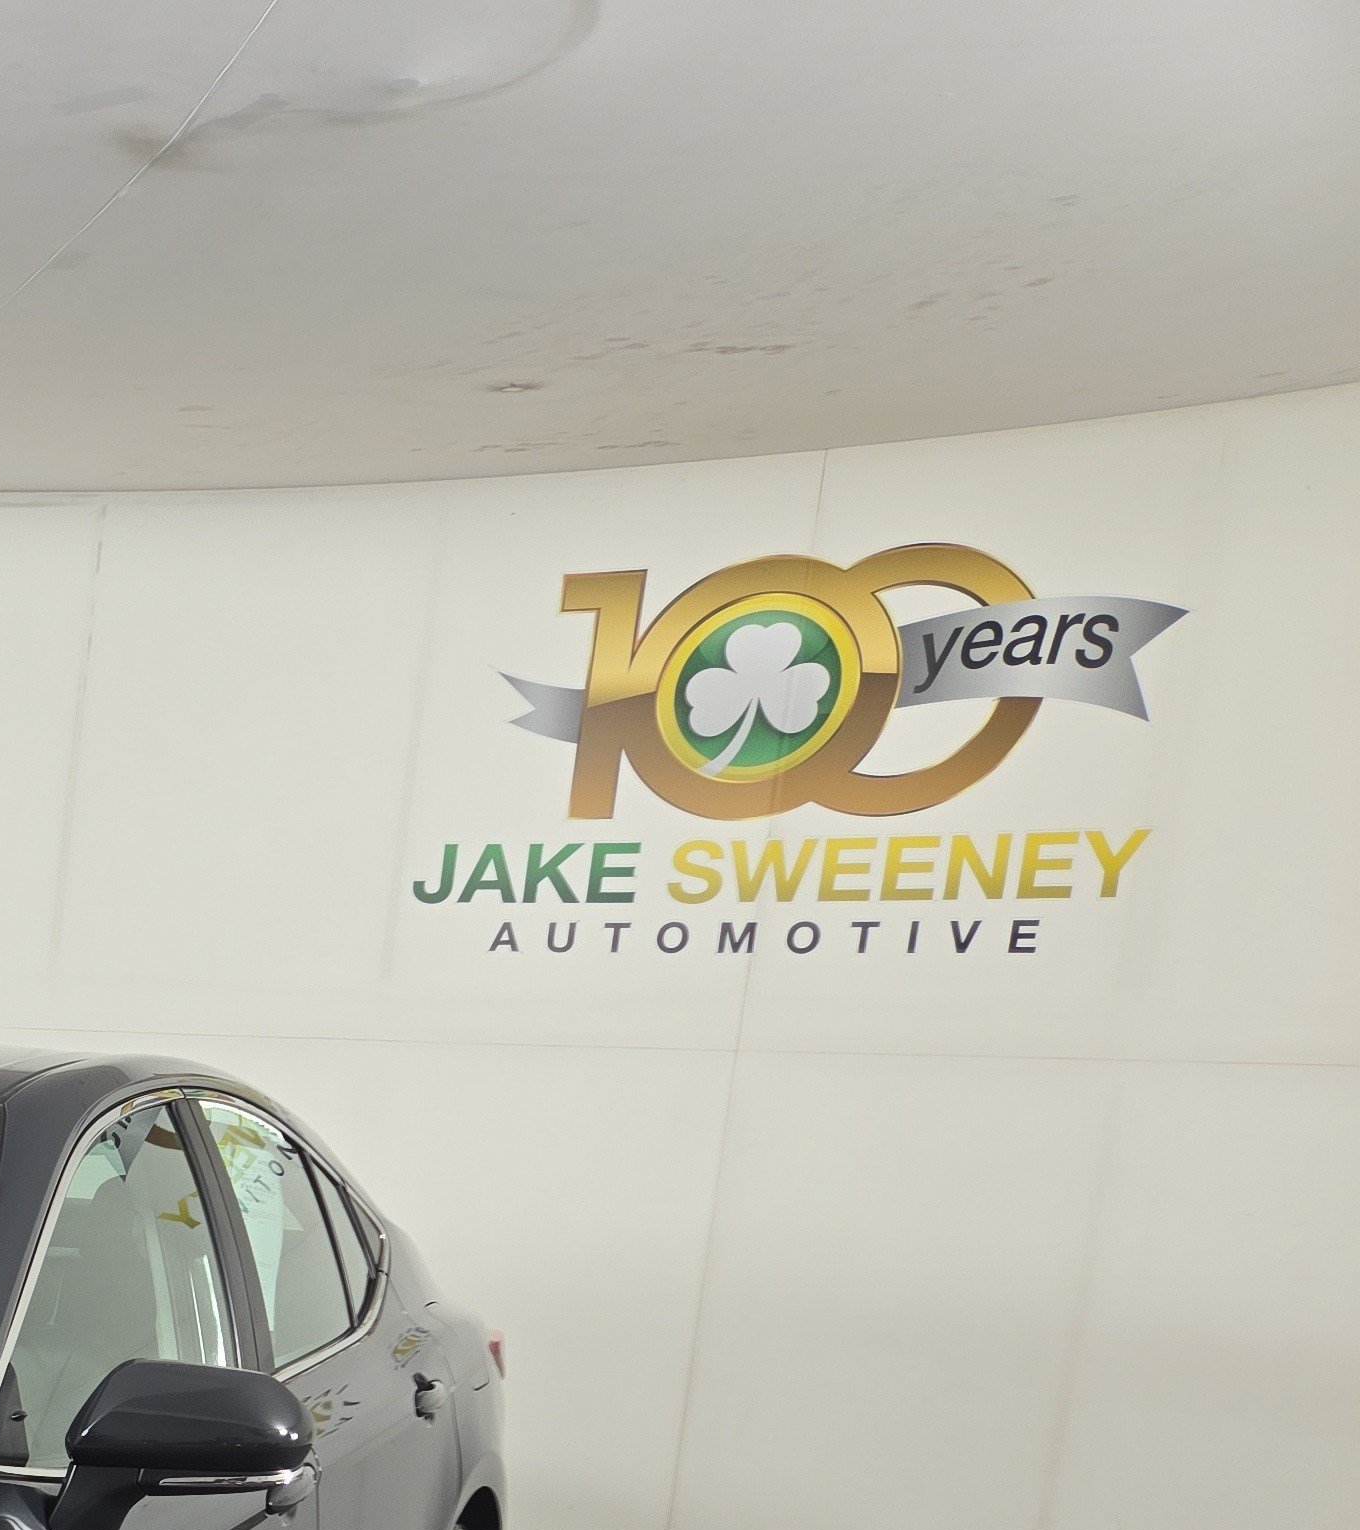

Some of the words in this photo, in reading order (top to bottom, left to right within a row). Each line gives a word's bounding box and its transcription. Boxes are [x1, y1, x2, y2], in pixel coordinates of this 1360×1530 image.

[560, 543, 1044, 822] 100
[912, 608, 1119, 695] years
[412, 842, 642, 905] JAKE
[666, 829, 1153, 906] SWEENEY
[488, 919, 1042, 956] AUTOMOTIVE
